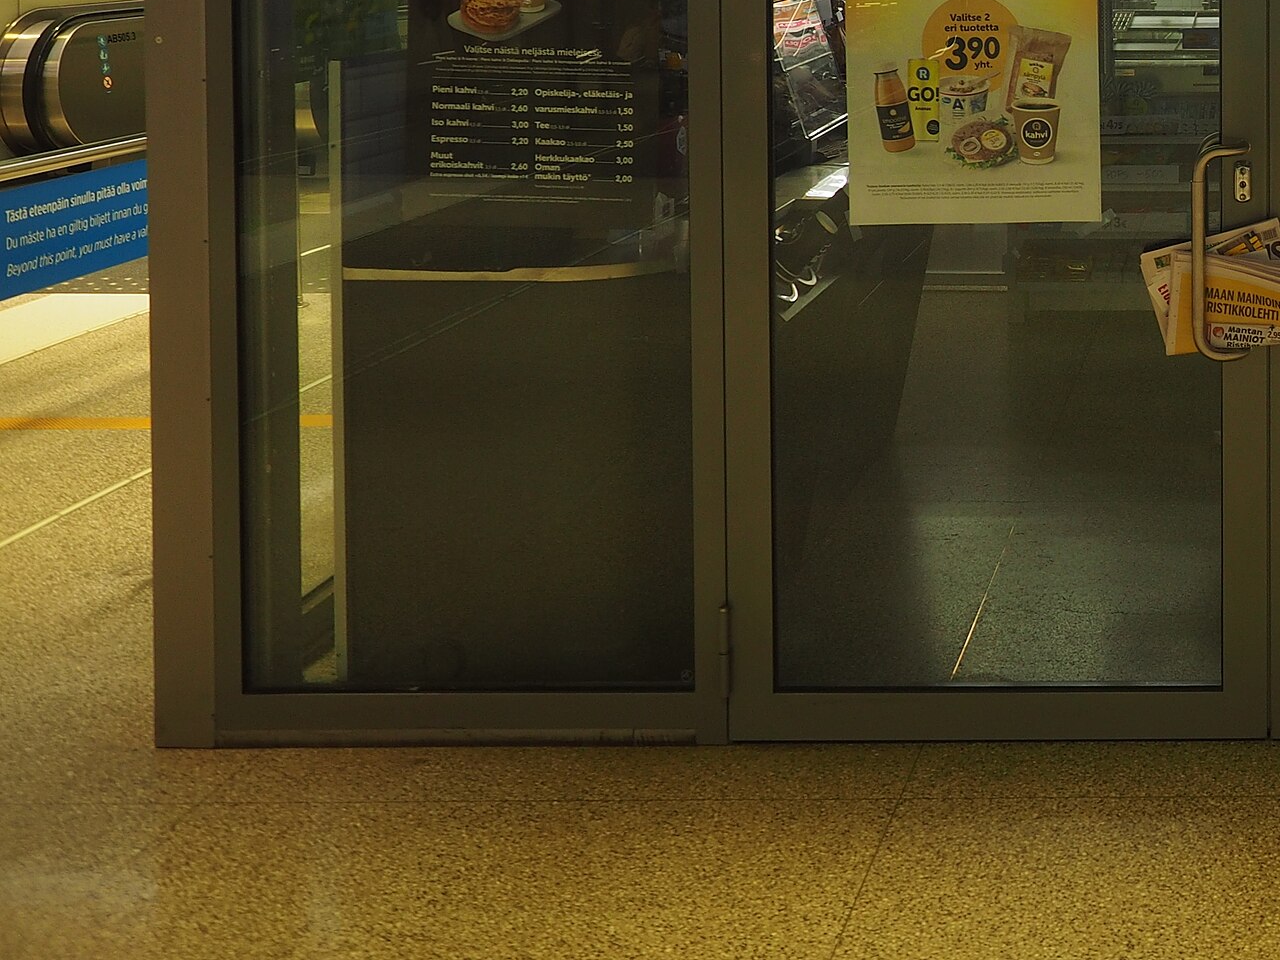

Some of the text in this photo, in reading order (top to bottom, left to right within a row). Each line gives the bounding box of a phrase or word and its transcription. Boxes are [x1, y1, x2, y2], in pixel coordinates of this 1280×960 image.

[950, 13, 991, 22] Valitse 2
[944, 23, 999, 33] eri tuotetta
[463, 44, 556, 58] Valitse näistä neljästä
[974, 60, 993, 71] yht.
[431, 84, 529, 97] Pieni kahvi 2,20
[624, 91, 634, 101] ja
[907, 86, 940, 103] GO!
[431, 101, 529, 114] Normaali kahvi 2,60
[616, 106, 634, 117] 1,50
[431, 118, 530, 131] Iso kahvi 3,00
[534, 120, 634, 133] Tee 1,50
[431, 134, 530, 147] Espresso 2,20
[1024, 129, 1049, 140] kahvi
[534, 137, 634, 150] Kaakao 2,50
[430, 151, 454, 160] Muut
[534, 154, 634, 166] Herkkukaakao 3,00
[430, 160, 529, 172] erikoiskahvit 2,60
[534, 163, 561, 172] Oman
[534, 172, 561, 182] mukin
[614, 174, 633, 184] 2,00
[5, 204, 28, 224] Tästä
[29, 194, 70, 219] eteenpäin
[70, 189, 96, 211] sinulla
[97, 184, 117, 204] pitää
[117, 182, 131, 197] olla
[6, 234, 19, 251] Du
[19, 227, 45, 247] måste
[46, 225, 56, 241] ha
[57, 225, 68, 238] en
[68, 216, 90, 238] giltig
[89, 210, 111, 231] biljett
[112, 208, 132, 225] innan
[132, 204, 142, 218] du
[6, 257, 39, 279] Beyond
[39, 252, 54, 268] this
[55, 245, 77, 267] point,
[78, 242, 94, 261] you
[95, 236, 113, 255] must
[113, 230, 131, 247] have
[131, 230, 138, 242] a
[1205, 303, 1280, 321] RISTIKKOLEHTI
[1227, 325, 1264, 336] Mantan
[1223, 333, 1266, 344] MAINIOT
